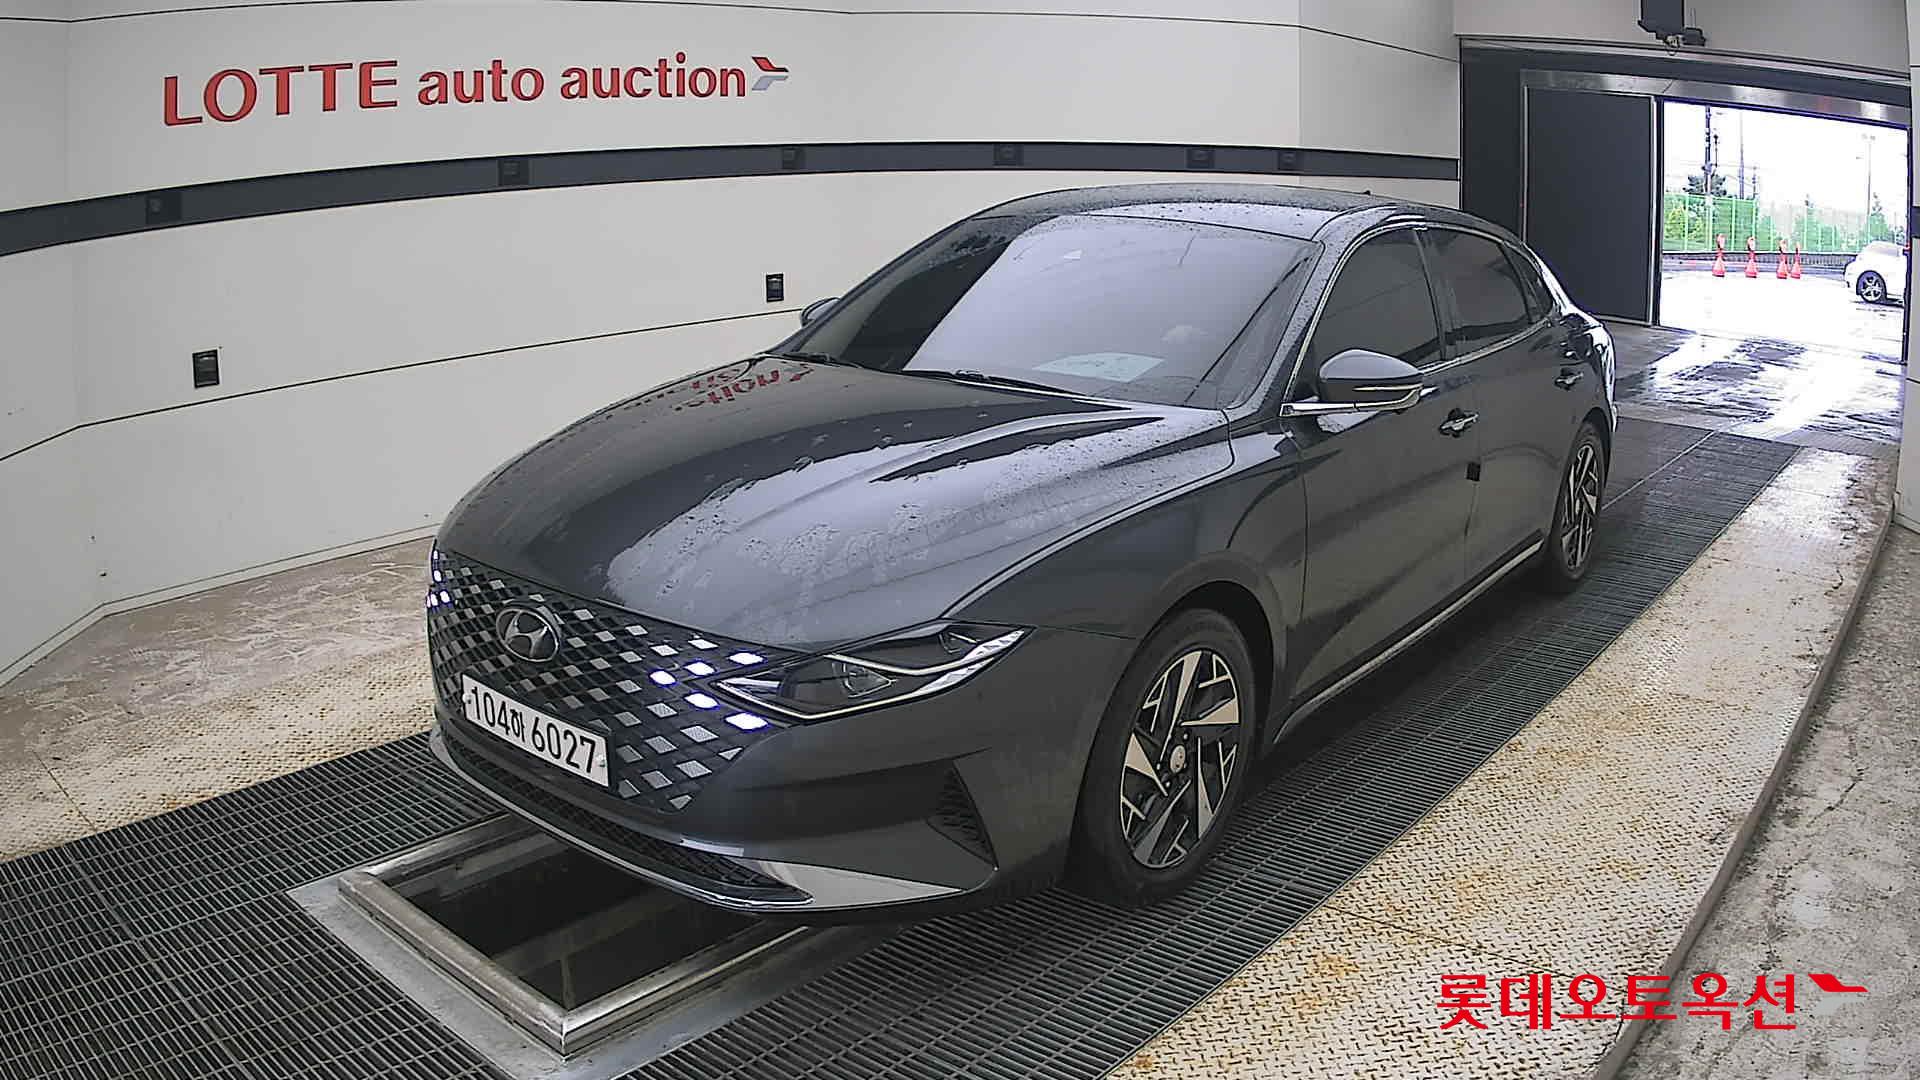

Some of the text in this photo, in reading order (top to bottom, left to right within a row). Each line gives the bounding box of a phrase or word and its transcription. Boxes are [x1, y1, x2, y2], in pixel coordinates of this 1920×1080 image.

[163, 52, 746, 126] LOTTE auto auction
[471, 686, 597, 774] 104하 6027
